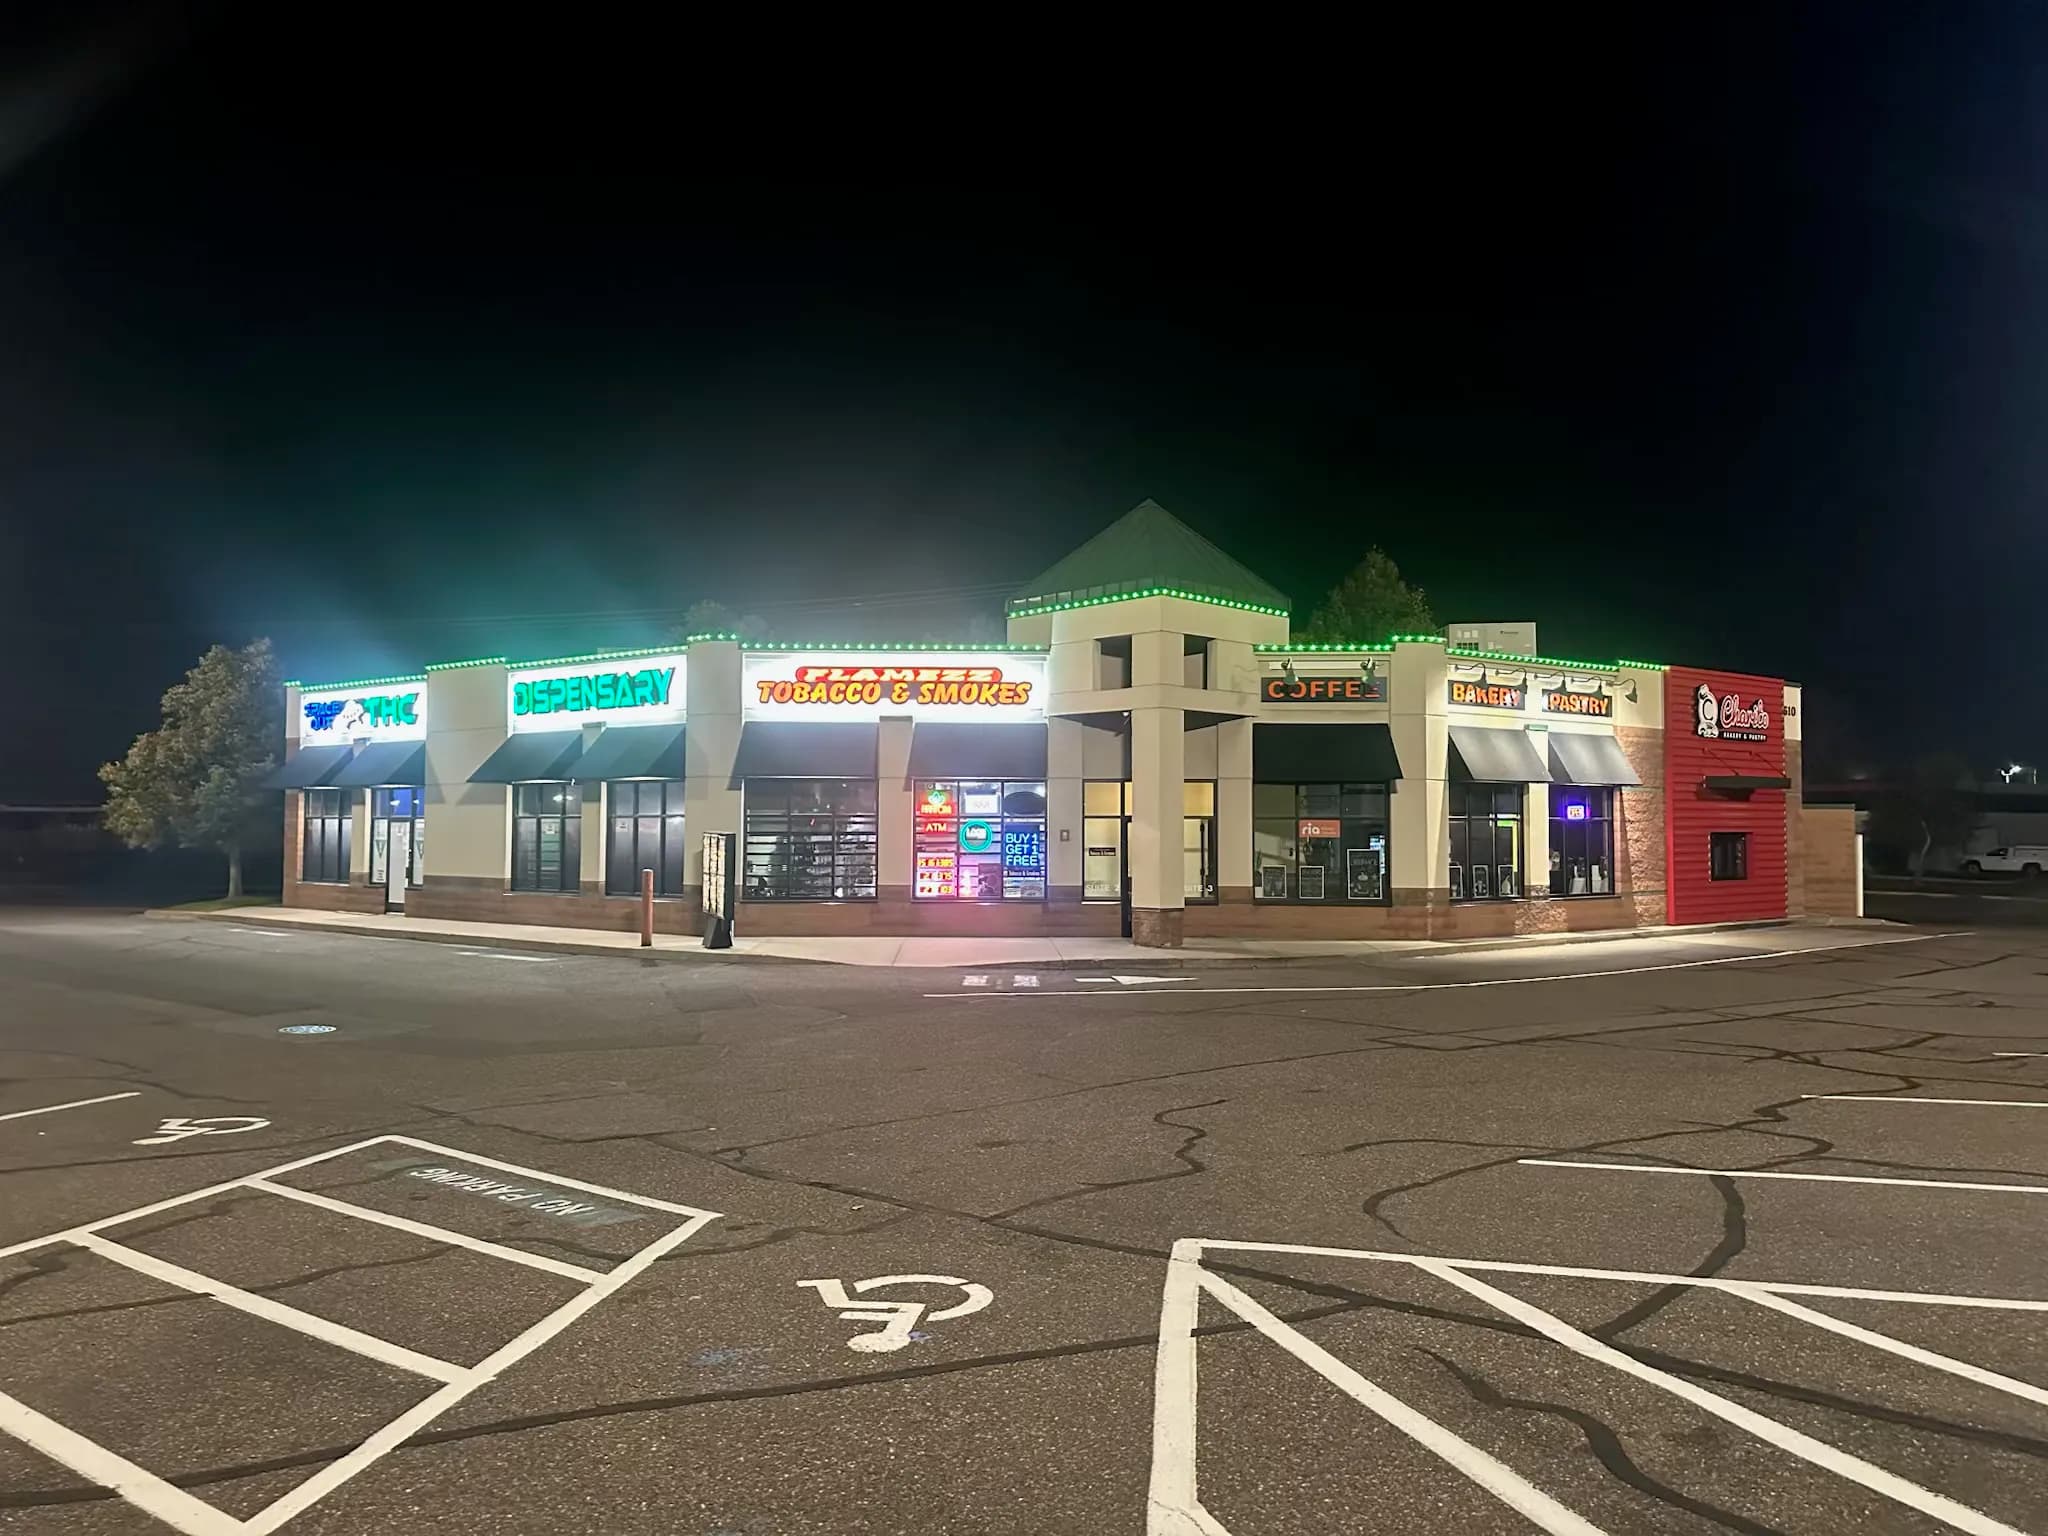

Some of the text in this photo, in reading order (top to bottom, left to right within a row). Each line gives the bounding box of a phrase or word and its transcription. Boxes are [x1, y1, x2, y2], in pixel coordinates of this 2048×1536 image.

[514, 668, 675, 715] DISPENSARY
[758, 681, 1031, 706] TOBACCO & SMOKES
[1452, 682, 1521, 707] BAKERY
[304, 700, 344, 718] SPACE
[363, 693, 419, 728] THC
[1549, 692, 1608, 714] PASTRY
[1723, 731, 1742, 739] BAKERY
[1748, 733, 1767, 741] PASTRY
[925, 823, 947, 832] ATM
[1302, 823, 1321, 835] ria
[1005, 833, 1039, 844] BUY 1
[1005, 844, 1039, 855] GET 1
[1006, 855, 1038, 867] FREE
[1205, 884, 1213, 893] 3
[410, 1168, 596, 1217] NO PARKING
